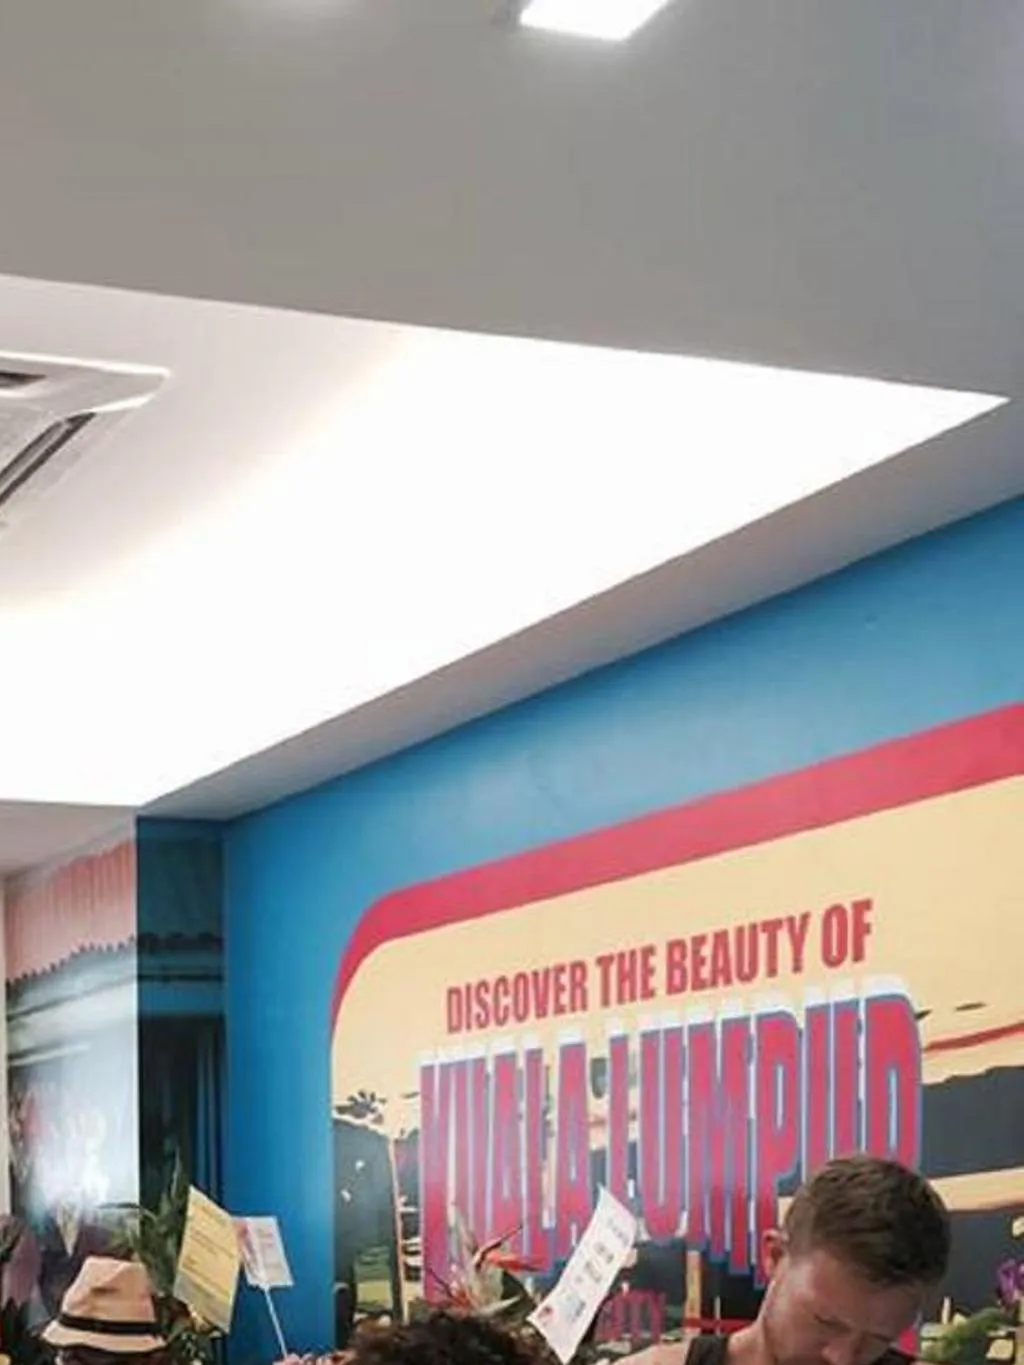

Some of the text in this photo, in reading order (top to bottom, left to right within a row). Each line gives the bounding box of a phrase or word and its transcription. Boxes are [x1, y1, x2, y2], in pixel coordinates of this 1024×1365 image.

[446, 898, 874, 1035] DISCOVER THE BEAUTY OF
